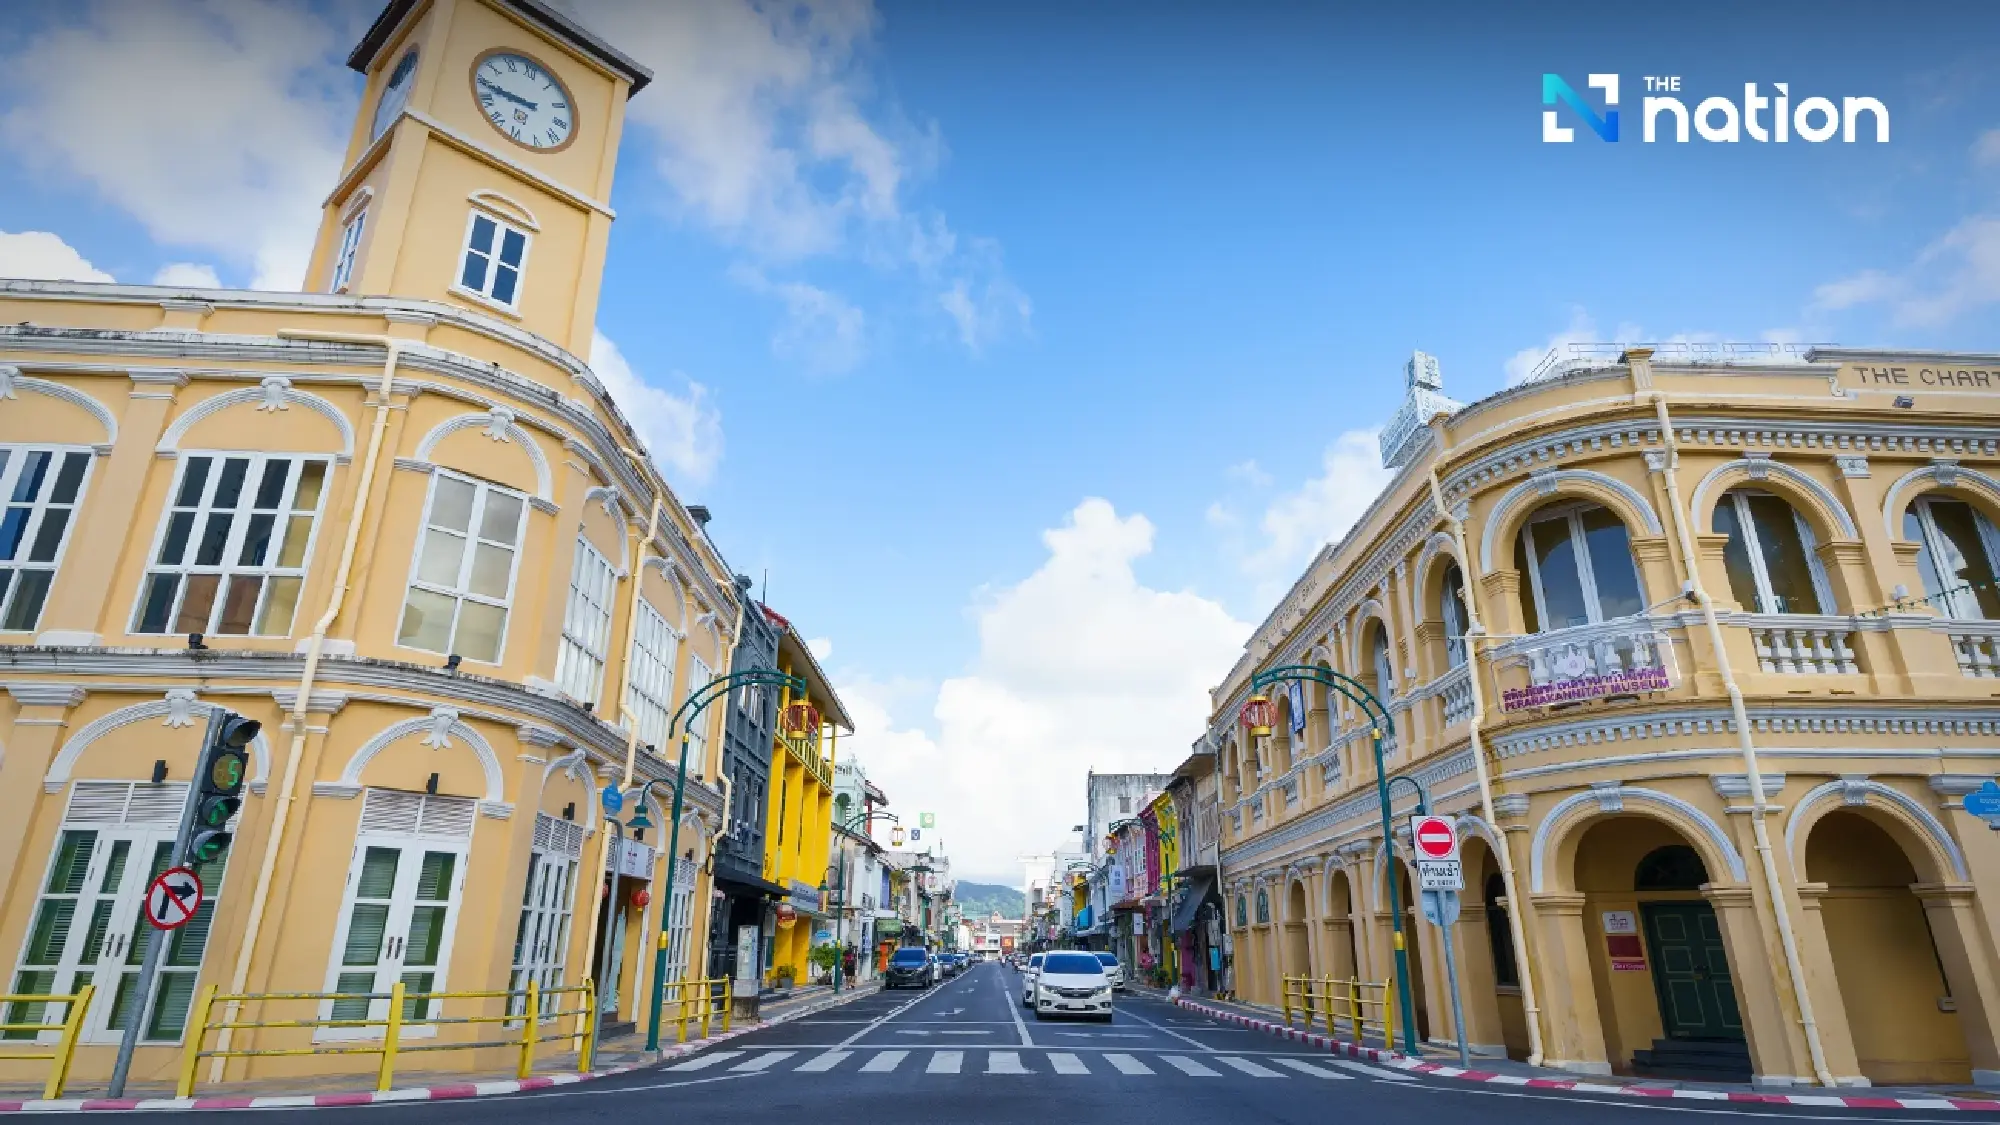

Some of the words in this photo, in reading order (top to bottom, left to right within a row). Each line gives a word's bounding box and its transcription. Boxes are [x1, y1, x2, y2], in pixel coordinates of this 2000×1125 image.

[1852, 366, 1910, 384] THE
[1610, 678, 1670, 695] MUSEUM
[228, 759, 240, 786] 5
